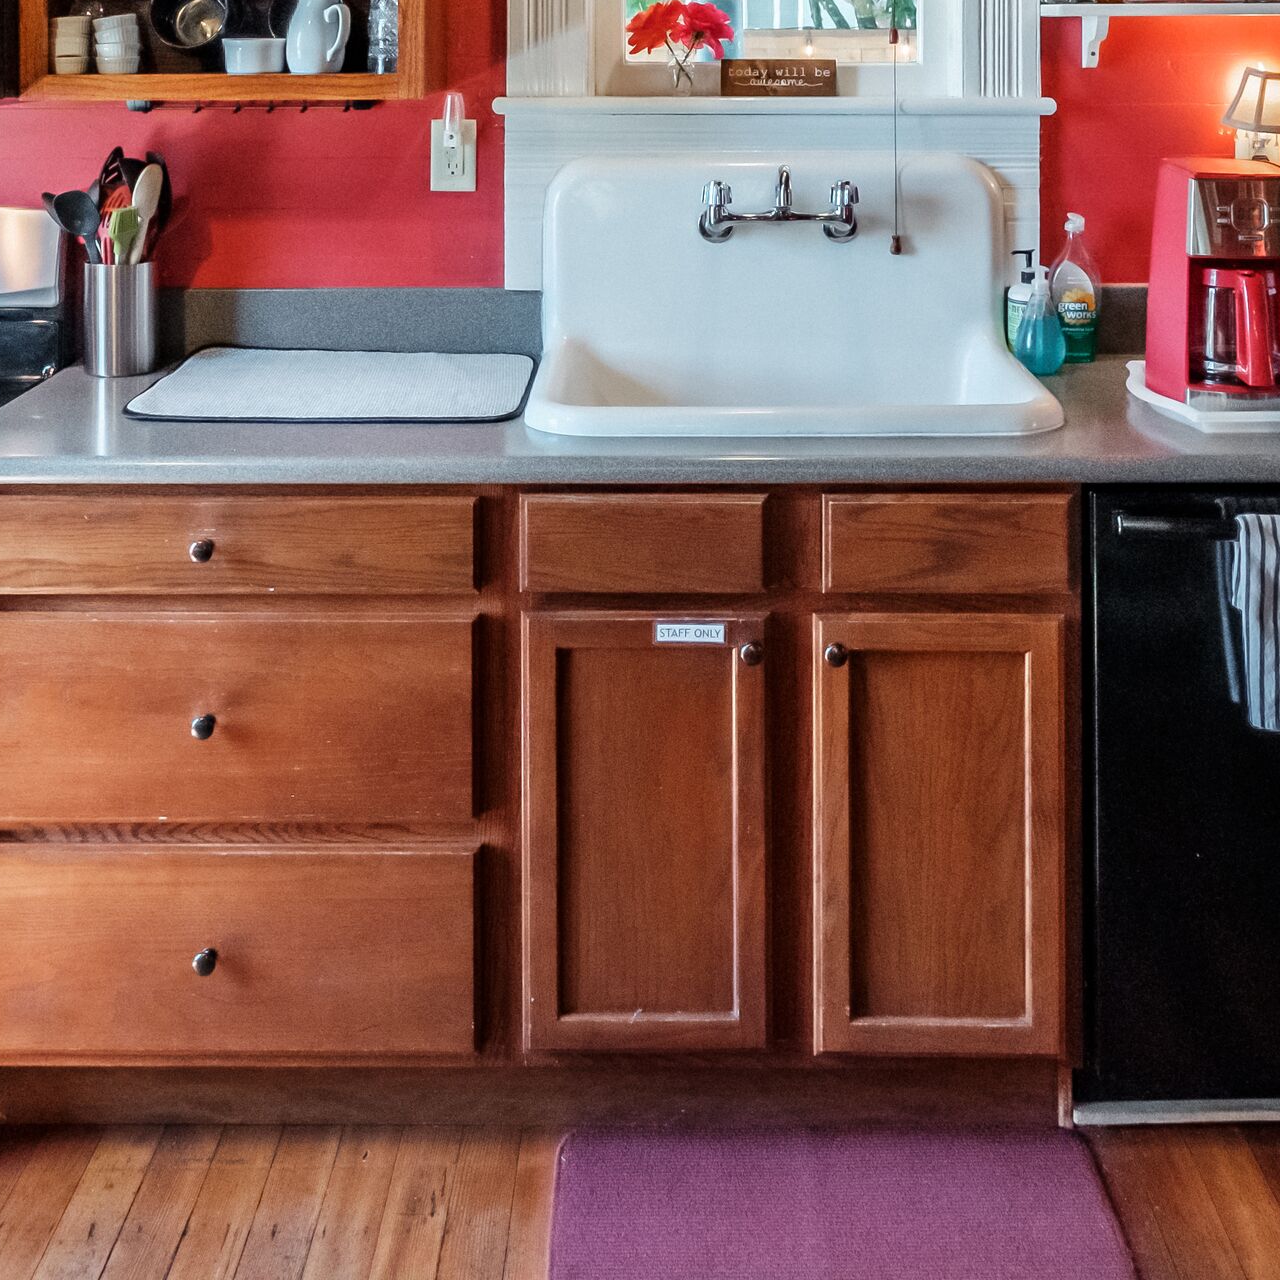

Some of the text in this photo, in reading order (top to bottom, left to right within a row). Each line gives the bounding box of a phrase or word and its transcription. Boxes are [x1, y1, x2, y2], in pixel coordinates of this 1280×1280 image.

[728, 67, 830, 78] today will be
[1058, 302, 1087, 312] green
[660, 628, 721, 638] STAFF ONLY
